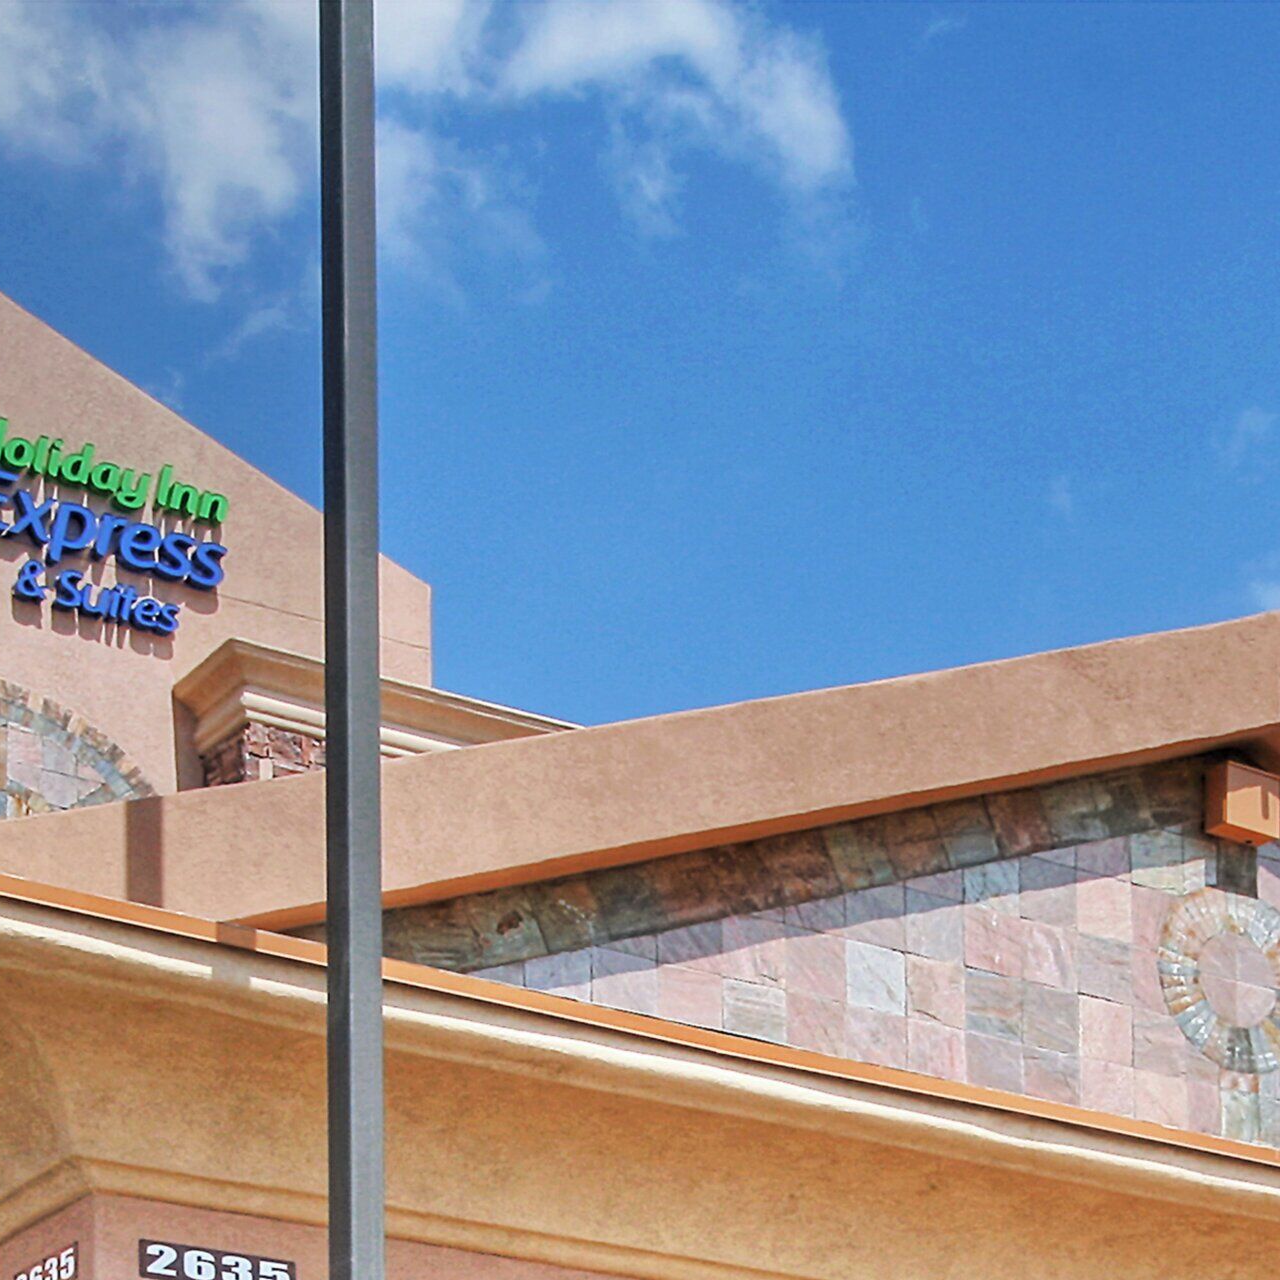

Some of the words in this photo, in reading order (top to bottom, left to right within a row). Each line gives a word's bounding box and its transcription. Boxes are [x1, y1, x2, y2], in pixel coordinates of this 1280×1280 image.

[157, 465, 229, 524] Inn
[13, 558, 46, 604] &
[53, 569, 180, 637] Suites
